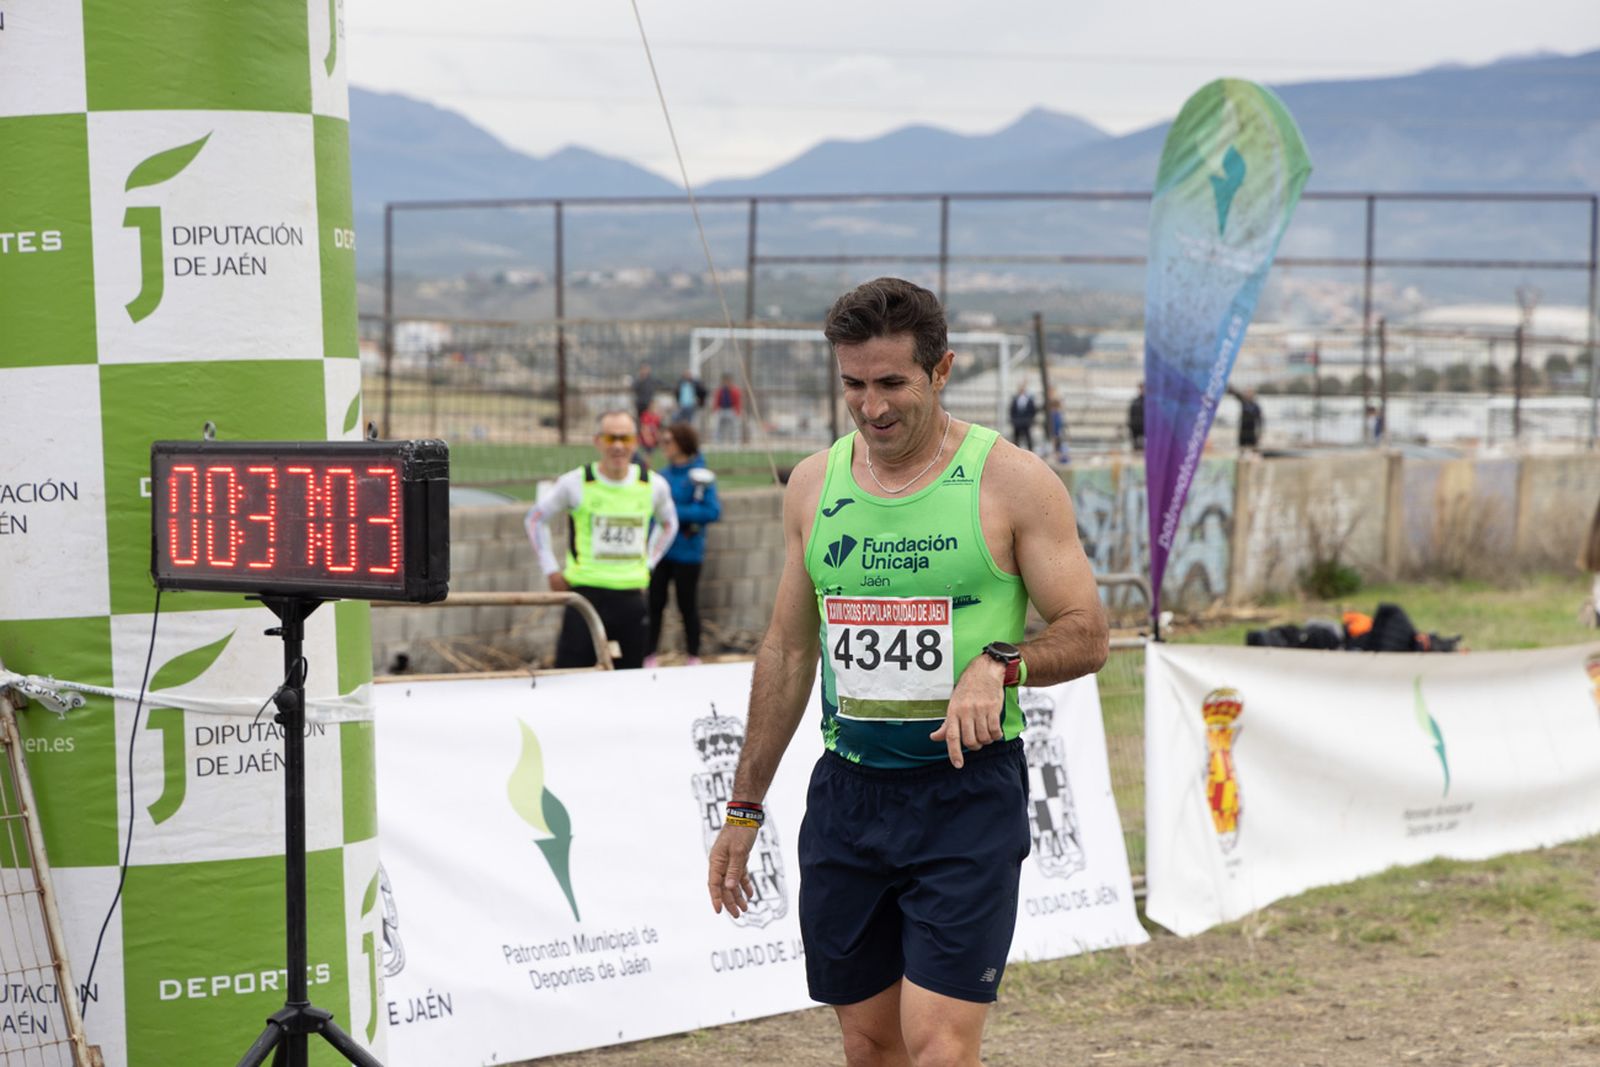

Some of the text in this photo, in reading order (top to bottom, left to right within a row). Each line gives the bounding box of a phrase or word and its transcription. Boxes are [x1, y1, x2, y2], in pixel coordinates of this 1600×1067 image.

[172, 222, 303, 246] DIPUTACIÓN
[174, 253, 267, 276] DE JAÉN
[0, 478, 79, 503] ACIÓN
[862, 534, 958, 553] Fundación
[862, 553, 929, 574] Unicaja
[860, 575, 891, 587] Jaén
[843, 603, 861, 622] CROSS
[862, 603, 891, 622] POPULAR
[892, 604, 916, 622] CIUDAD
[917, 604, 927, 622] DE
[834, 628, 943, 671] 4348
[196, 756, 229, 777] DE
[502, 924, 659, 965] Patronato Municipal de
[711, 945, 765, 973] CIUDAD
[767, 941, 788, 963] DE
[529, 953, 651, 992] Deportes de Jaén
[405, 987, 453, 1023] JAÉN
[0, 1011, 47, 1034] AÉN
